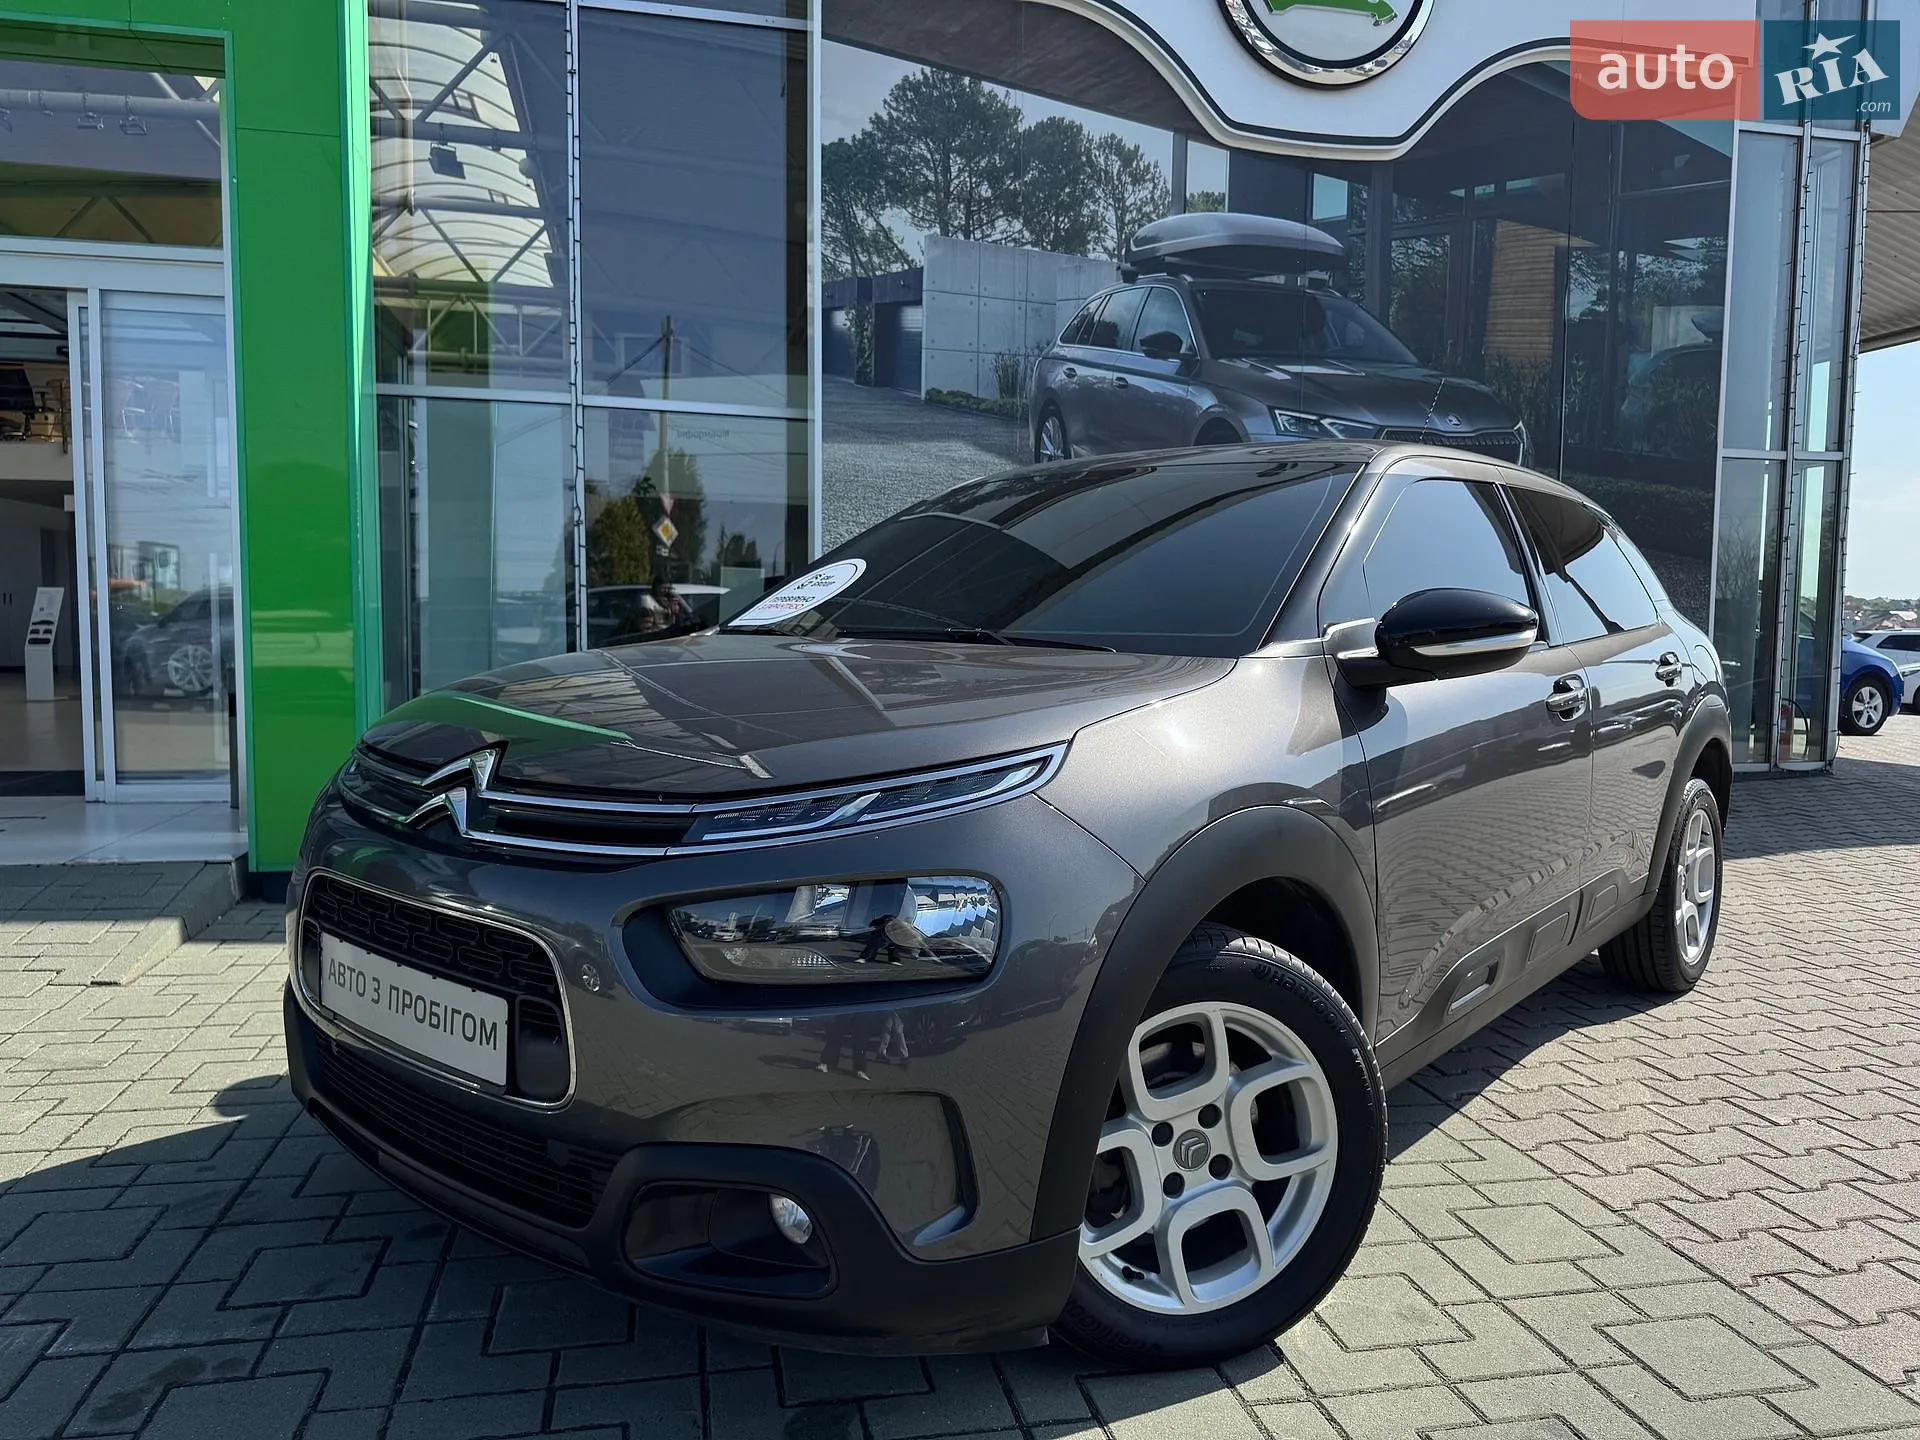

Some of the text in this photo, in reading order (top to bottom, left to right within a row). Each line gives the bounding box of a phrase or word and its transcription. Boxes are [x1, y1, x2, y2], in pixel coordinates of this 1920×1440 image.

[328, 958, 498, 1051] АВТО З ПРОБІГОМ
